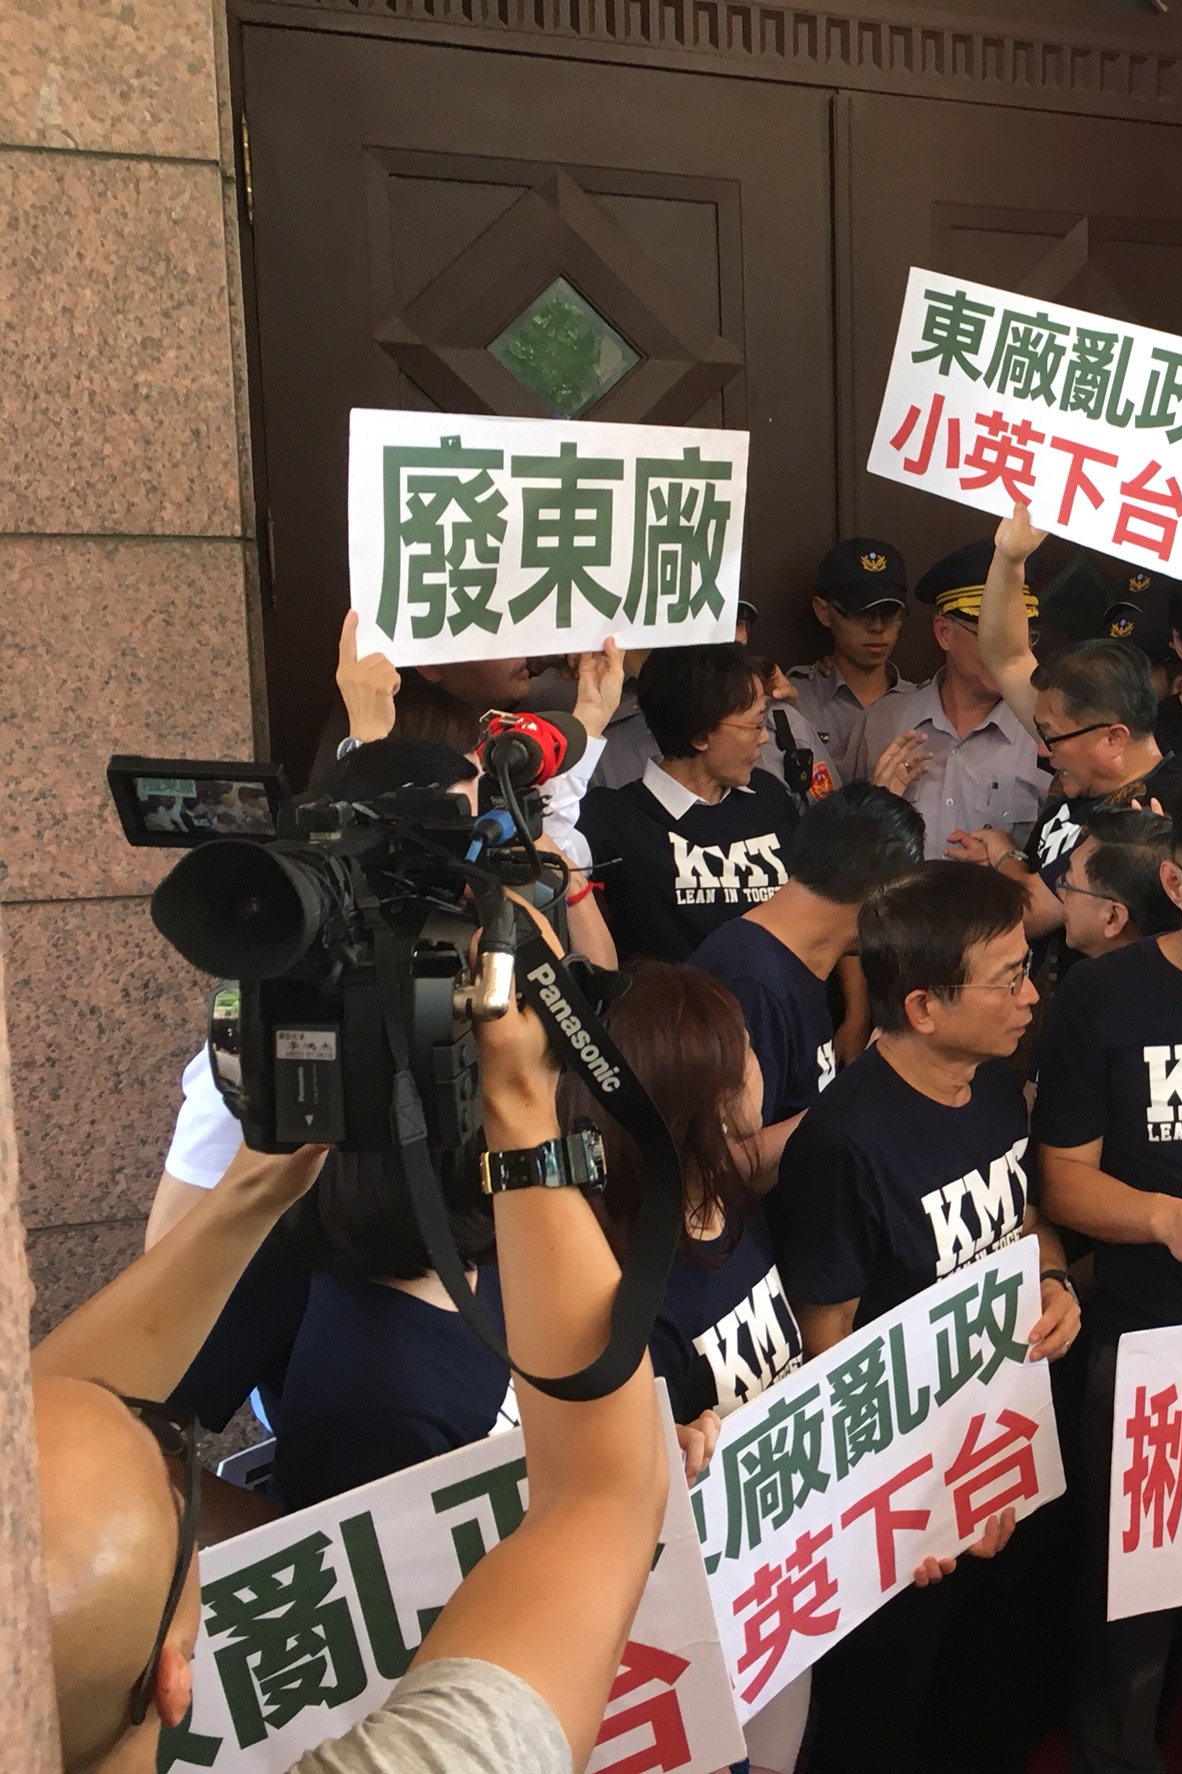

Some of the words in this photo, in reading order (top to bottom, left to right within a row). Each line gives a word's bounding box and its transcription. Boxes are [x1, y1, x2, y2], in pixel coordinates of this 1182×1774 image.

[375, 434, 733, 640] 廢東廠
[668, 831, 789, 889] KMT
[675, 889, 716, 905] LEAN
[724, 888, 739, 904] IN
[526, 962, 621, 1093] Panasonic
[731, 1409, 1039, 1704] 英下台
